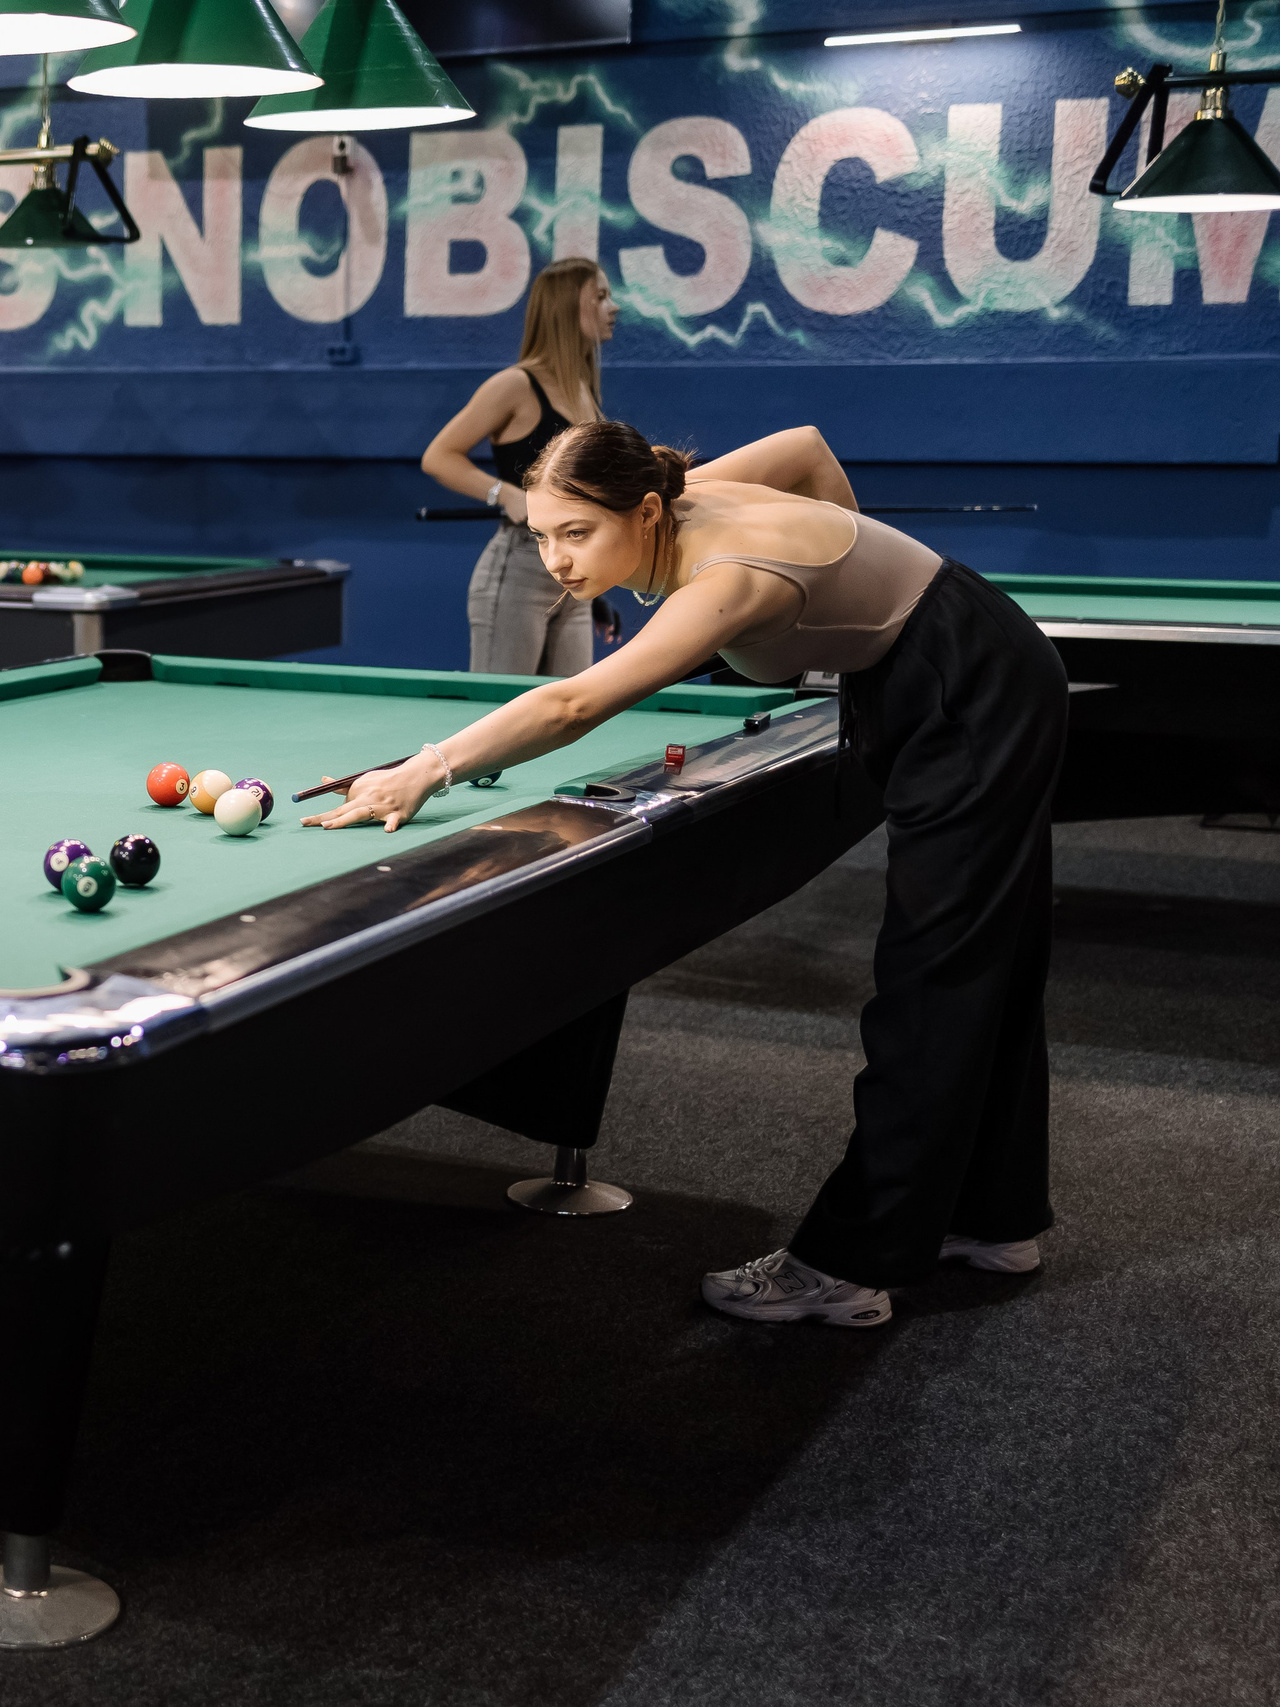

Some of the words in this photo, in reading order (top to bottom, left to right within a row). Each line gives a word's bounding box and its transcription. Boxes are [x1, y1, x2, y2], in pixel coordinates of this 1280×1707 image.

[179, 782, 185, 792] 3
[251, 788, 261, 798] 12
[773, 1271, 806, 1294] N
